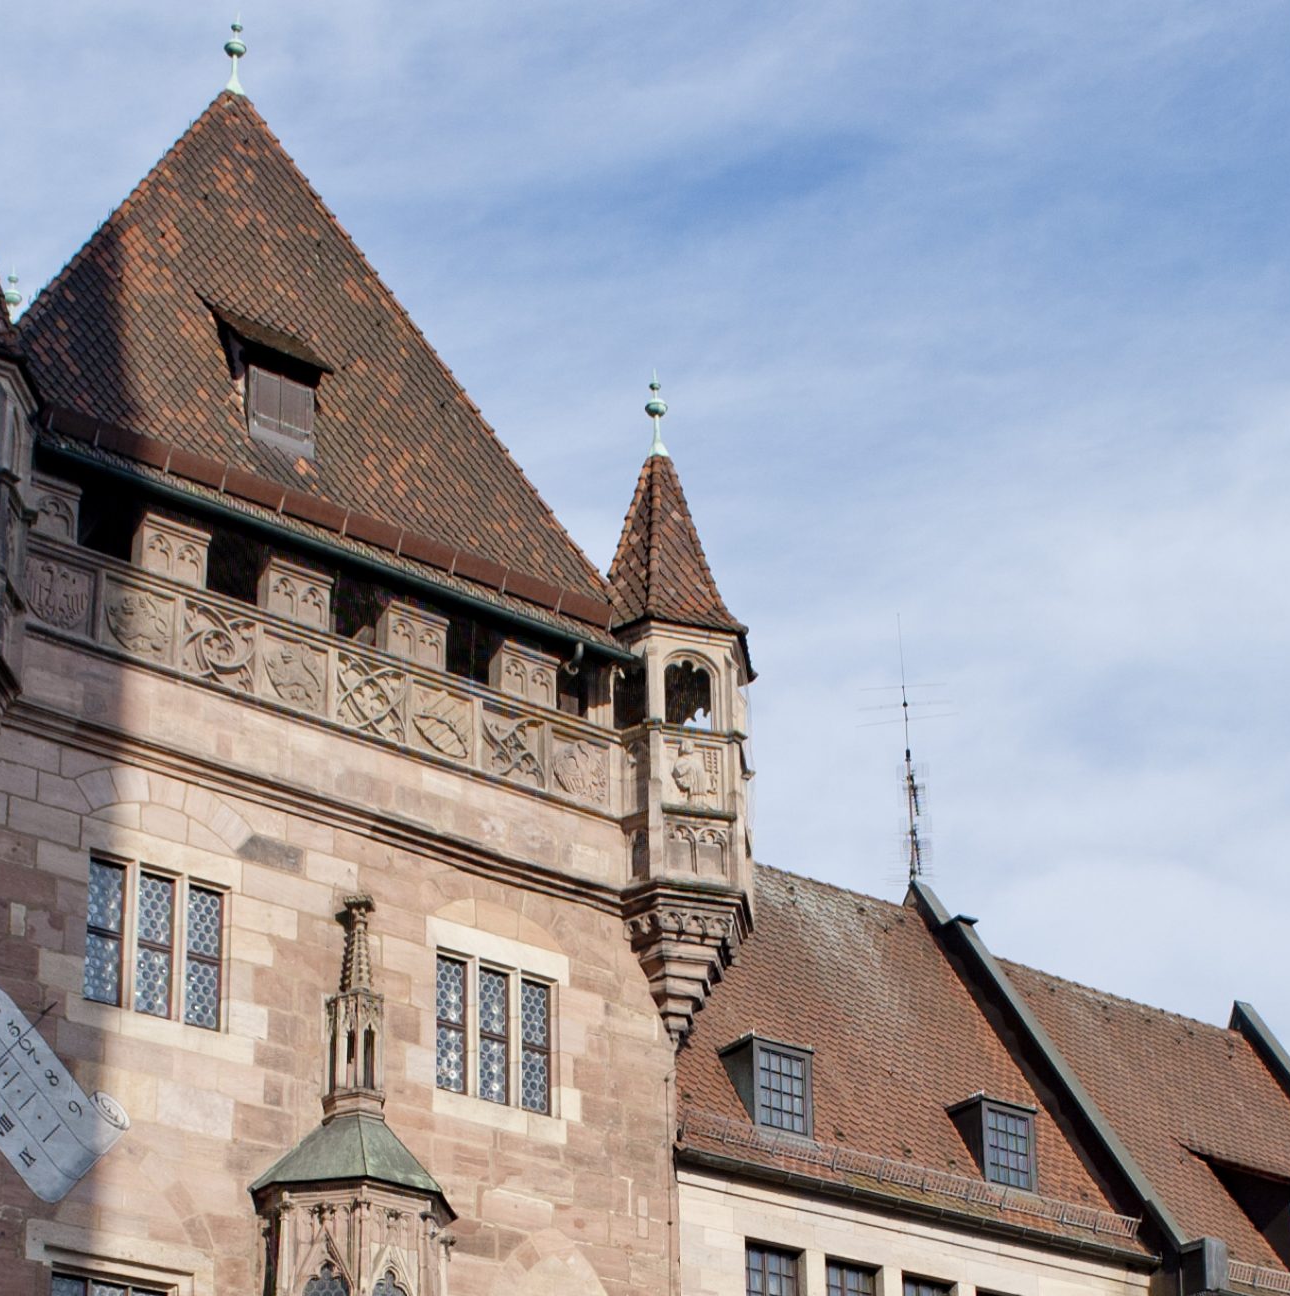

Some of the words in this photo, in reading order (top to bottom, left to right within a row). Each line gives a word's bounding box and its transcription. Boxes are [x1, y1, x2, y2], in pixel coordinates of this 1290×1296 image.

[7, 1019, 20, 1037] 5
[44, 1069, 59, 1087] 8
[69, 1101, 82, 1118] 9
[18, 1146, 36, 1168] IX
